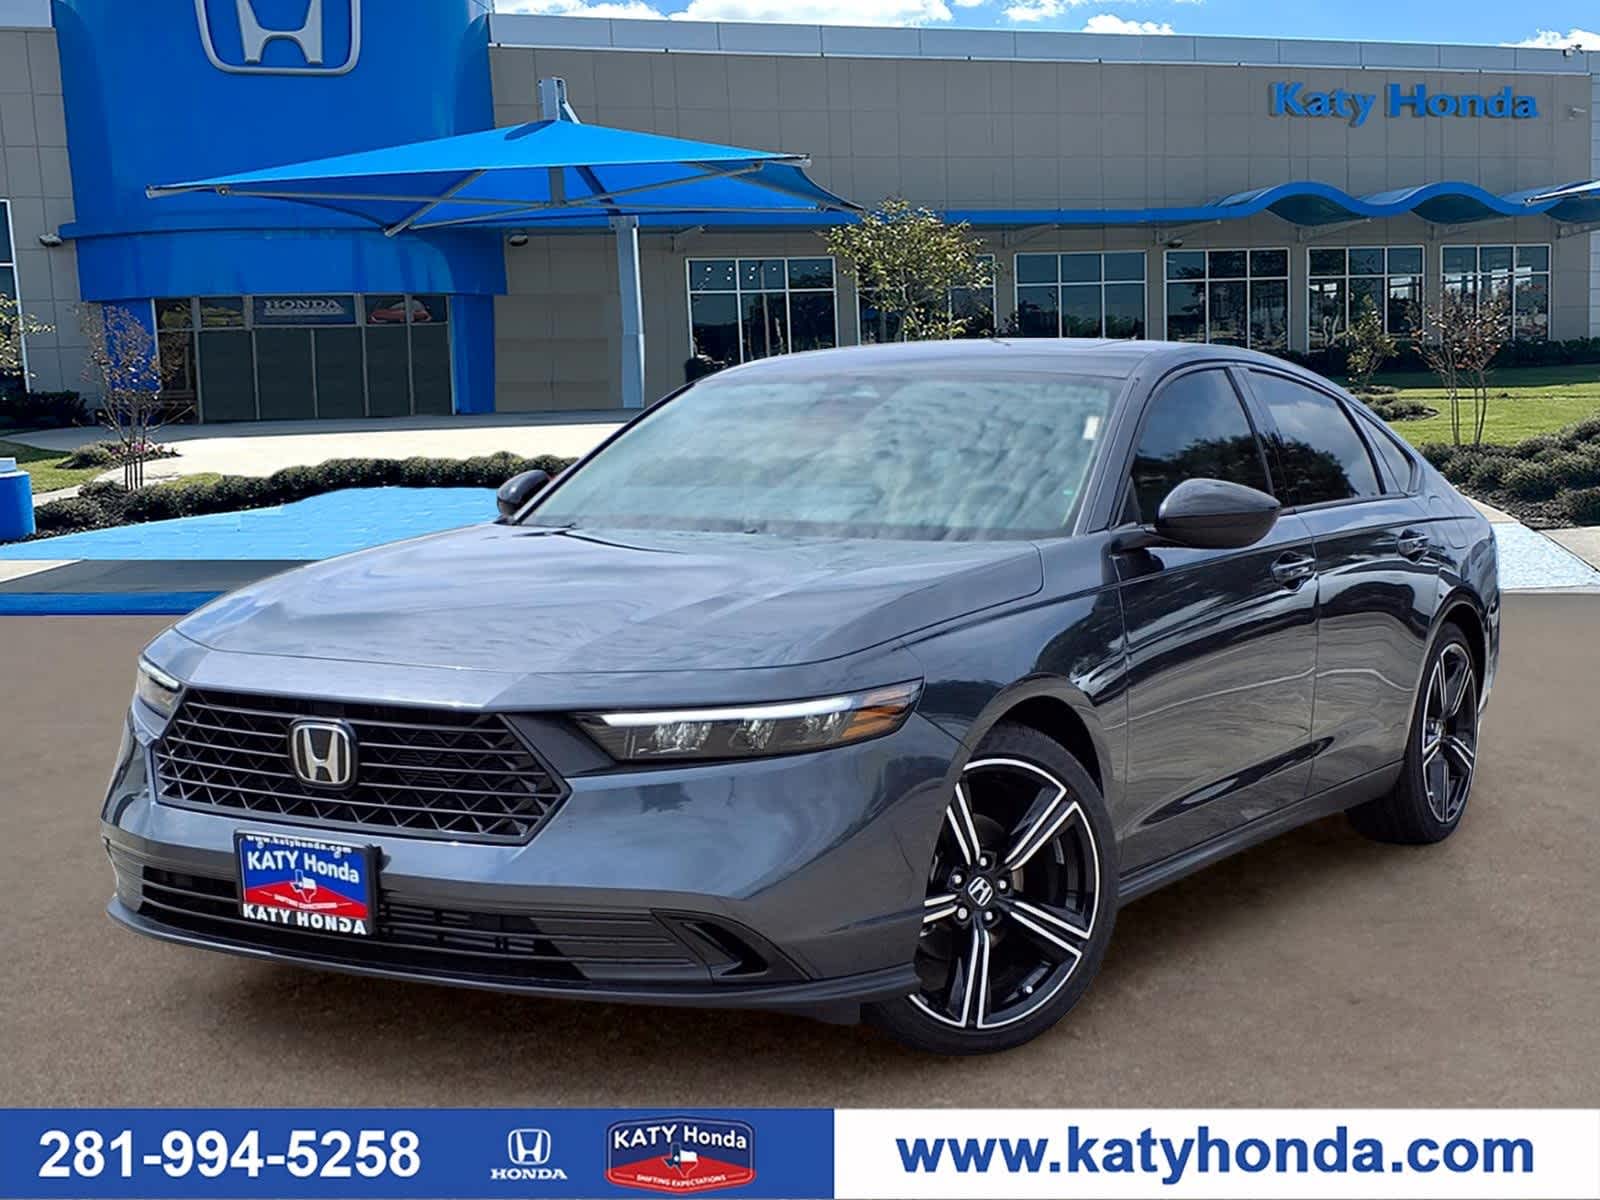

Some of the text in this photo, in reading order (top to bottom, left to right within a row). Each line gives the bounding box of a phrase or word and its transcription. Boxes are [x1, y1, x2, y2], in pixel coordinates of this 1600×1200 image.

[1271, 82, 1539, 127] Katy Honda
[264, 299, 342, 310] HONDA
[246, 835, 353, 853] www.katyhonda.com
[247, 850, 360, 884] KATY Honda
[243, 903, 367, 935] KATY HONDA
